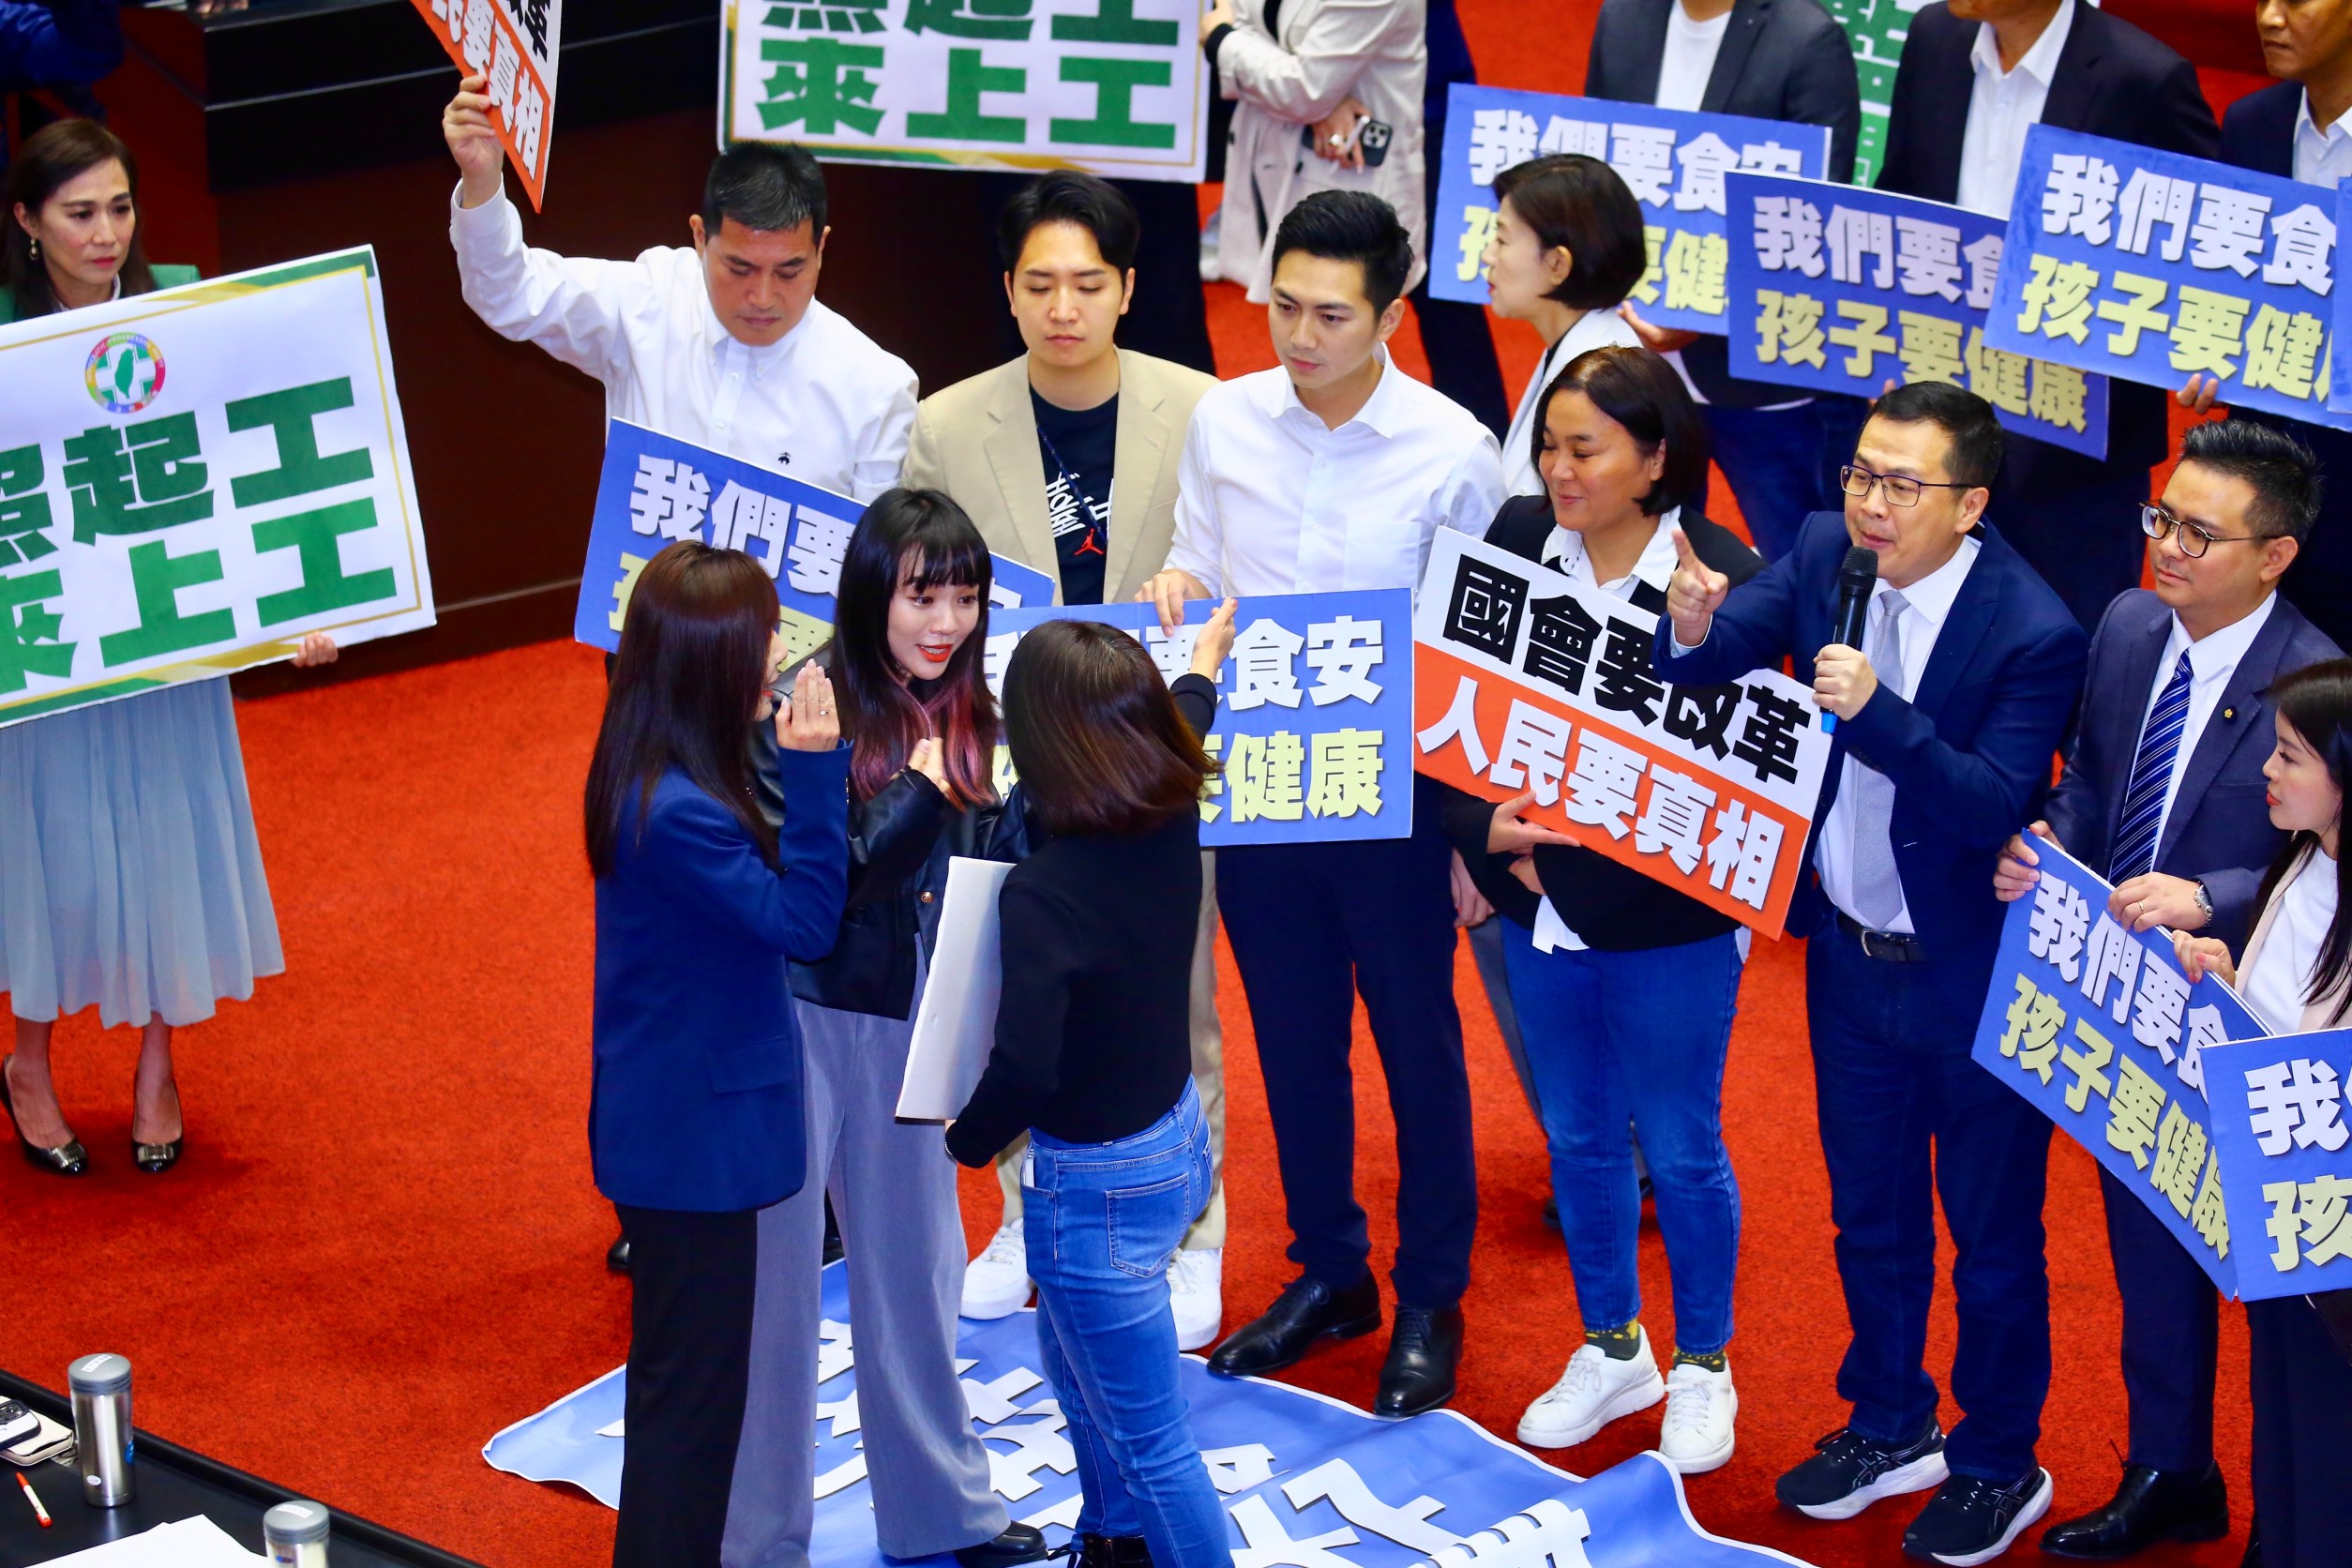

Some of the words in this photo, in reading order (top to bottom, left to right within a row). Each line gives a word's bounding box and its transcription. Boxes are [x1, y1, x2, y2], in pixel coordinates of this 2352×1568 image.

[755, 37, 1179, 149] 來上工
[2042, 154, 2337, 296] 我們要食
[2016, 253, 2332, 403] 孩子要健
[1442, 553, 1811, 785] 國會要改革
[1416, 675, 1785, 912] 人民要真相
[2244, 1058, 2352, 1156] 我
